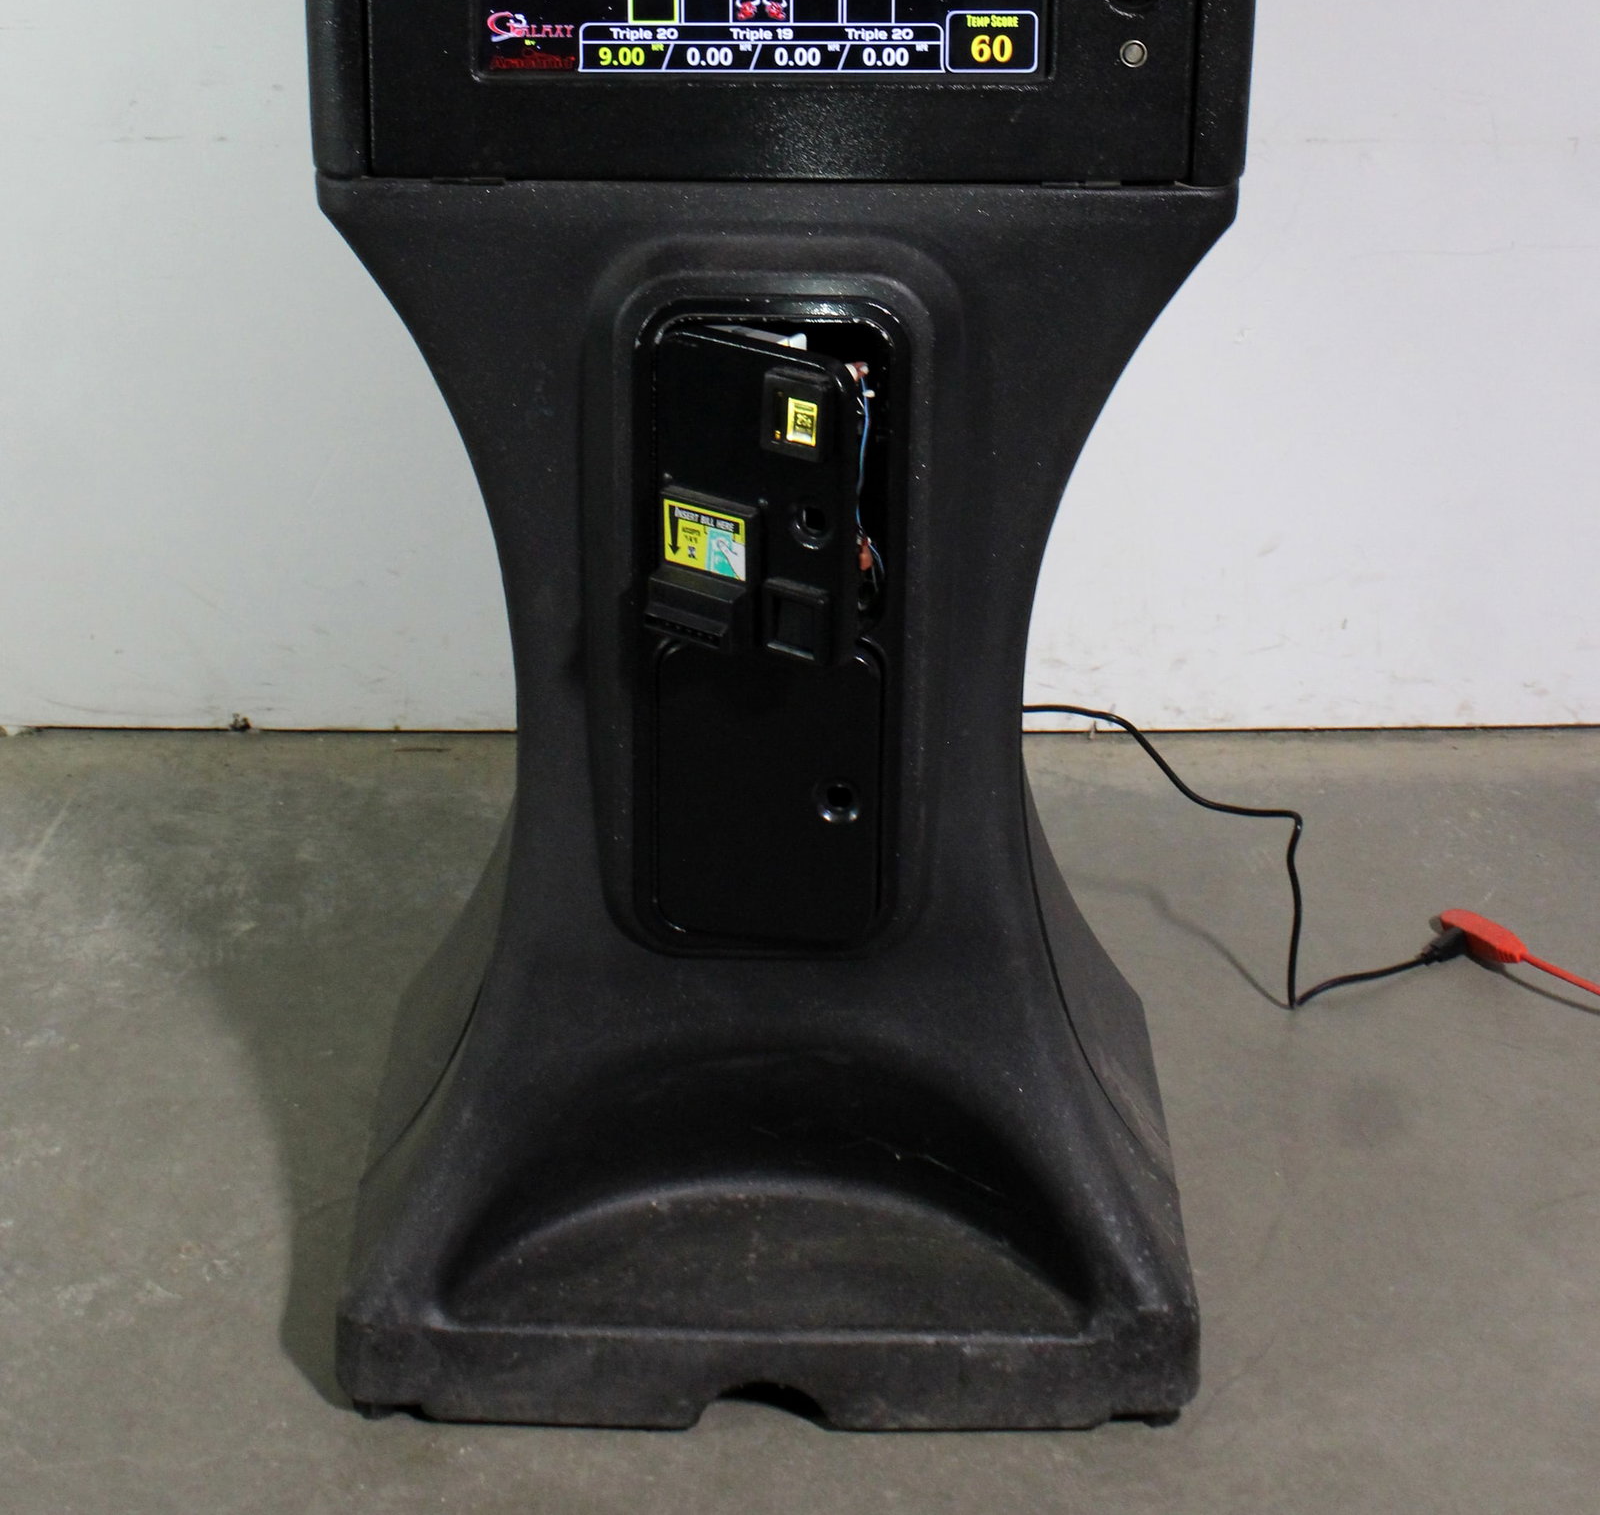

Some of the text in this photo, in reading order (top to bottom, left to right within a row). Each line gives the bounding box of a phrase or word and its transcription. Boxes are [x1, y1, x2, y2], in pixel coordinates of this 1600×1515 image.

[609, 27, 678, 41] Triple 20
[729, 27, 794, 41] Triple 19
[845, 27, 914, 41] Triple 20
[598, 46, 645, 67] 9.00
[686, 46, 733, 67] 0.00
[774, 47, 821, 67] 0.00
[862, 47, 909, 67] 0.00
[970, 35, 1014, 64] 60
